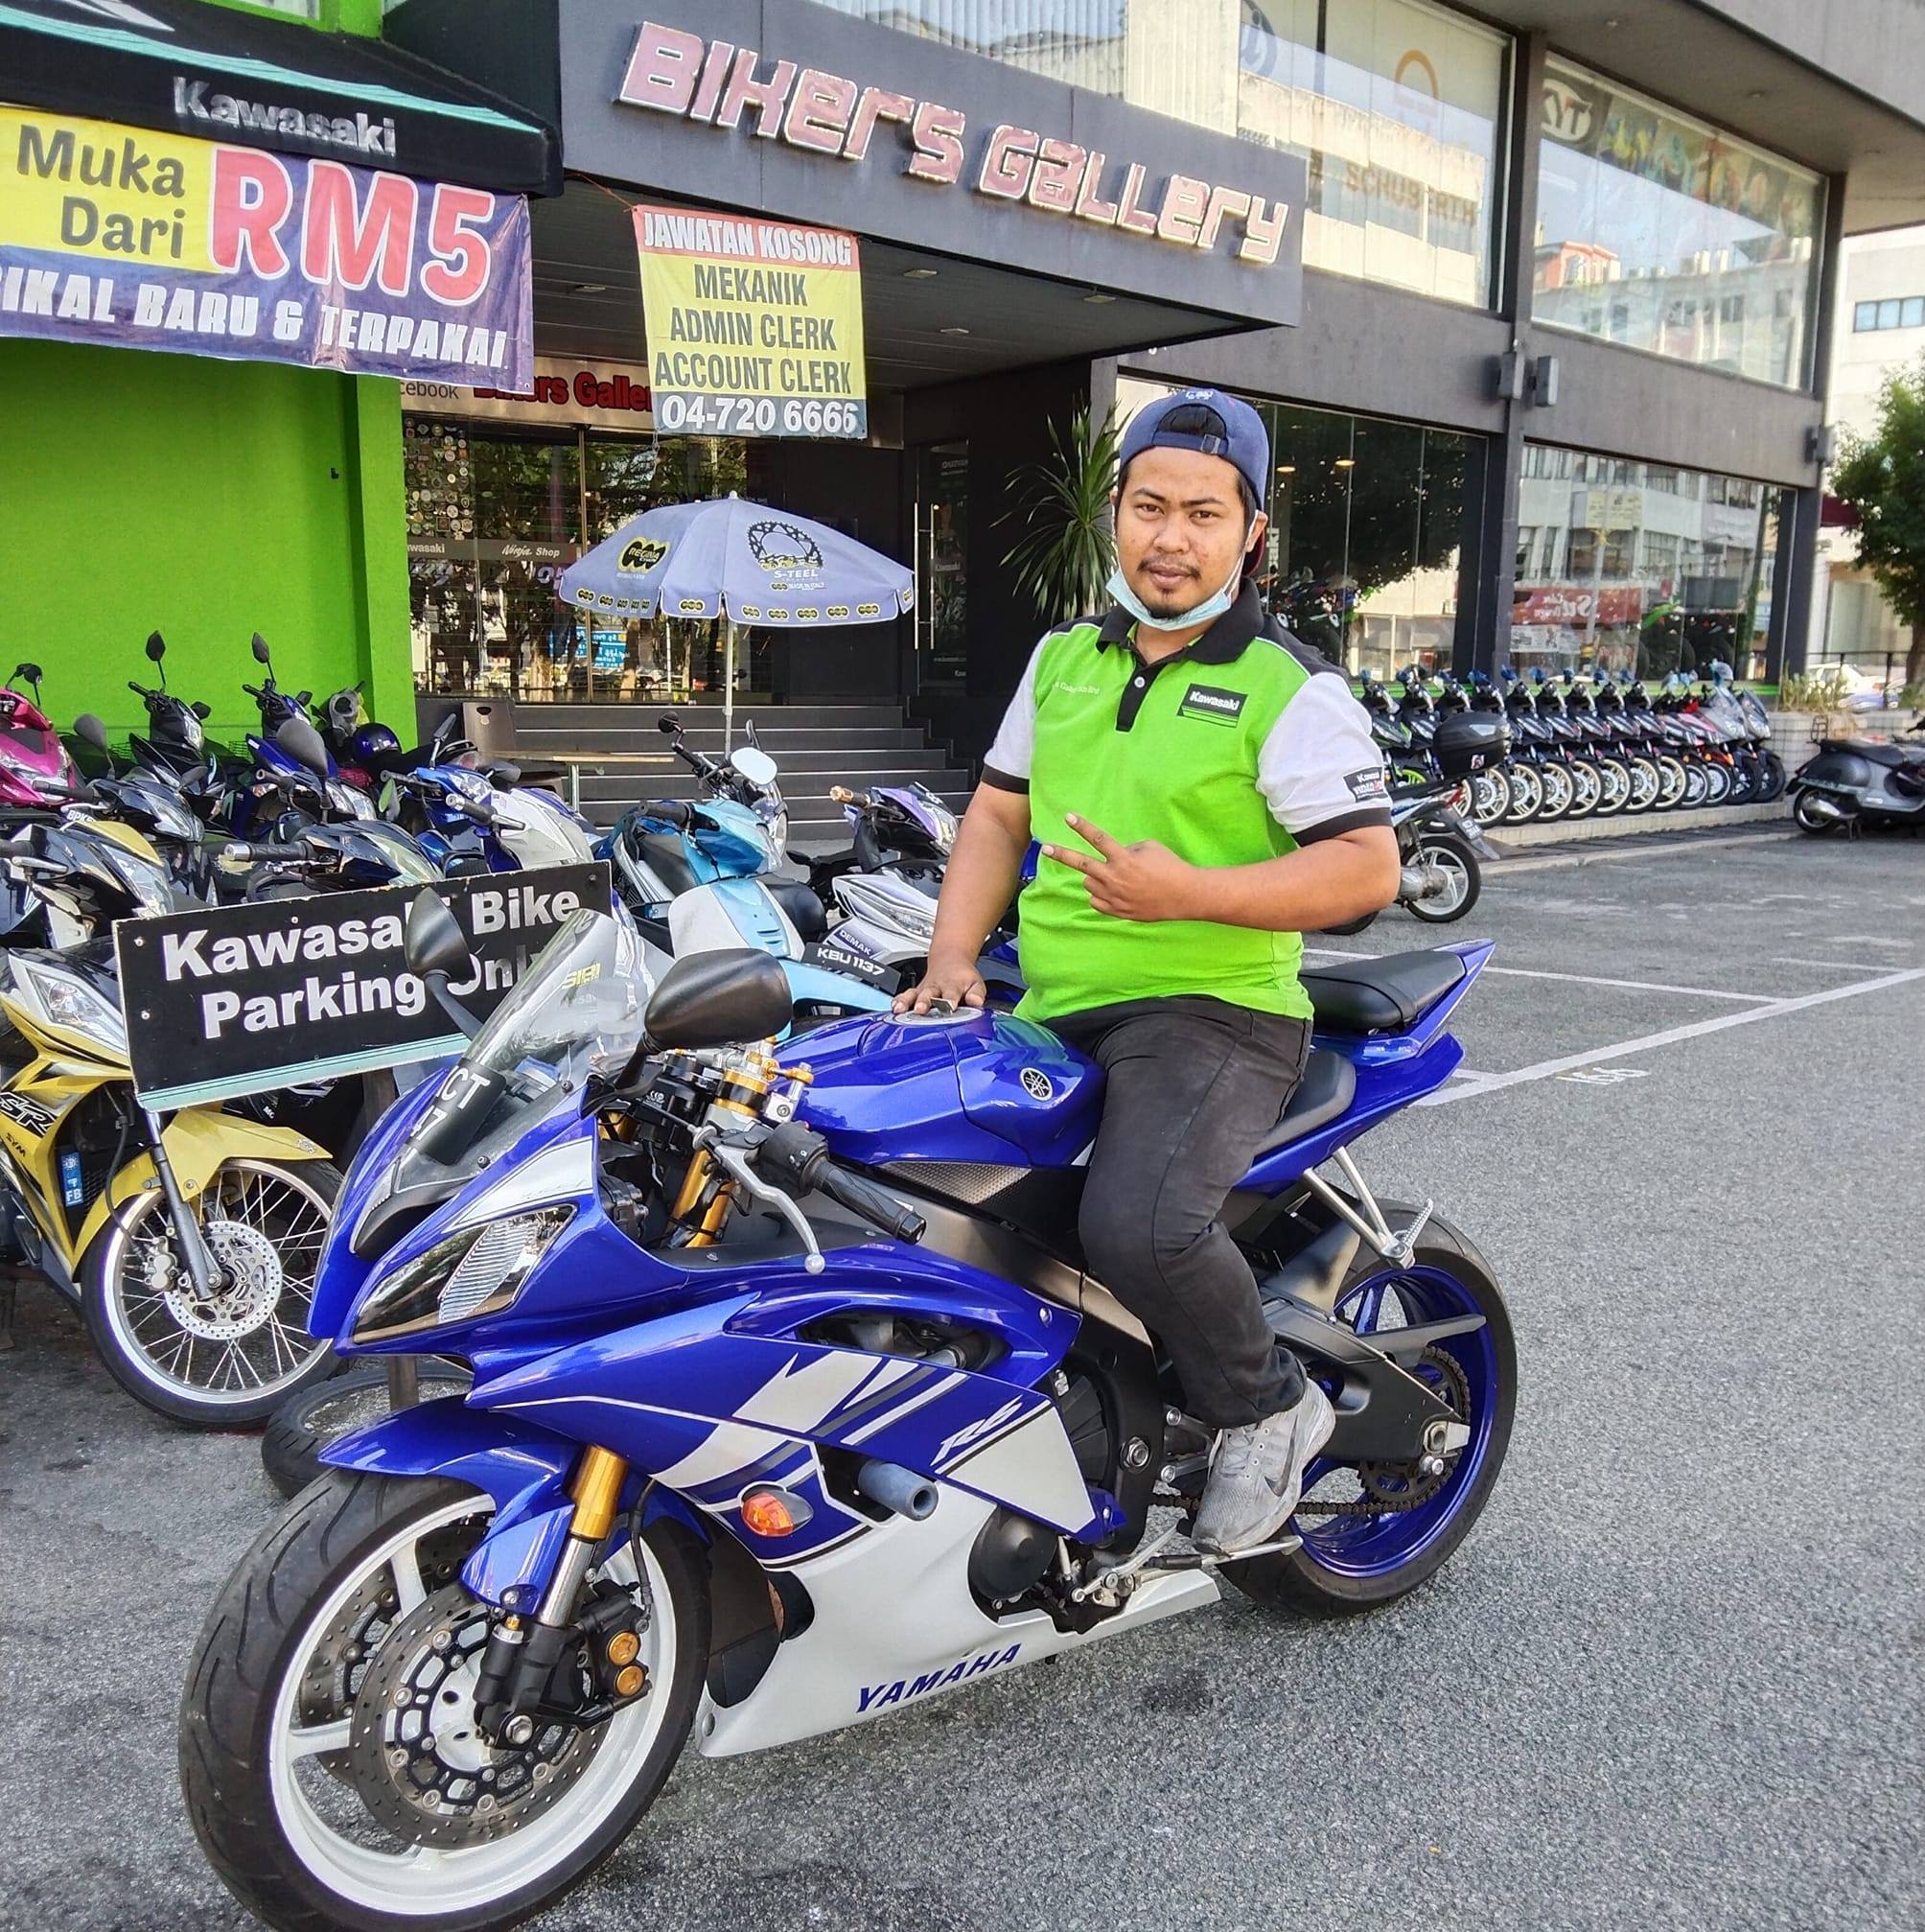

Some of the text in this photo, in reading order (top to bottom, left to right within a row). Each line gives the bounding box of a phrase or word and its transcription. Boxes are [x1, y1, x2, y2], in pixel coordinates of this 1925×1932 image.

[173, 76, 396, 157] Kawasaki
[17, 125, 185, 198] Muka
[60, 196, 185, 259] Dari
[210, 146, 496, 306] RM5
[643, 212, 851, 266] JAWATAN KOSONG
[694, 264, 807, 306] MEKANIK
[0, 267, 507, 368] IKAL BARU & TERPAKAI
[671, 308, 837, 351] ADMIN CLERK
[655, 352, 851, 394] ACCOUNT CLERK
[661, 395, 859, 433] 04-720 6666
[535, 547, 560, 558] Shop
[1189, 690, 1240, 710] Kawasaki
[162, 885, 580, 983] Kawasa Bike
[817, 946, 885, 976] KBU 1137
[839, 929, 872, 956] DEMAK
[201, 944, 540, 1040] Parking Onl
[856, 1641, 1022, 1714] YAMAHA
